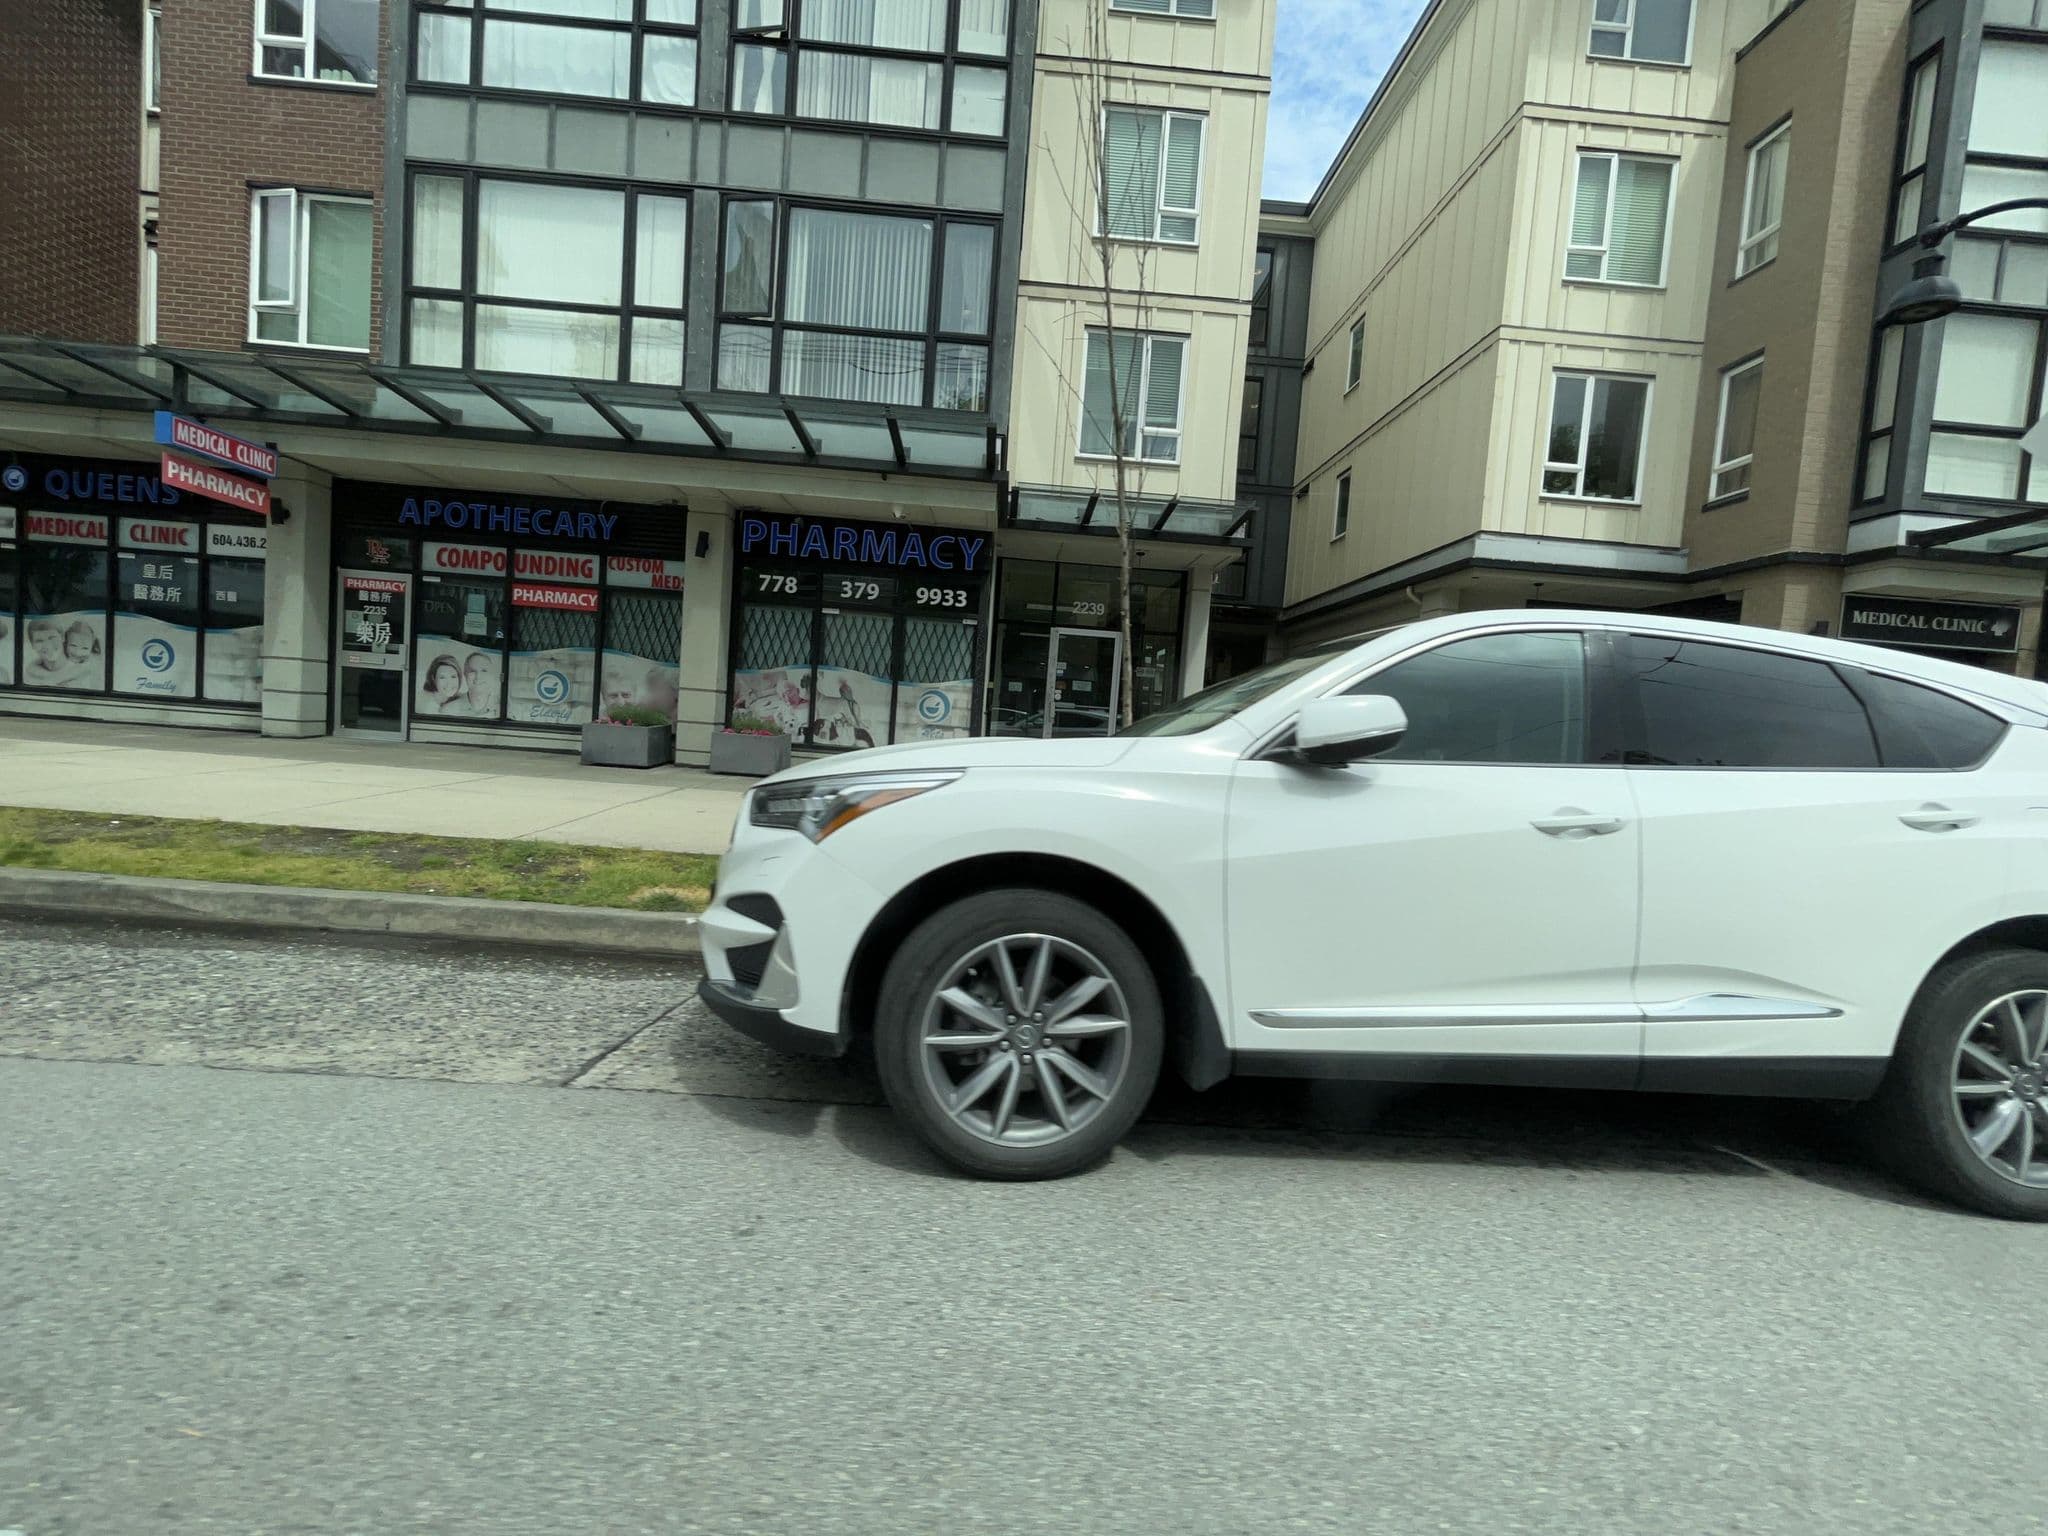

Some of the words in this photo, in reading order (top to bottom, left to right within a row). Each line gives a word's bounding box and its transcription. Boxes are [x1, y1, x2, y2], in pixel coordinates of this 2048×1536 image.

[177, 422, 232, 457] MEDICAL
[236, 443, 273, 472] CLINIC
[45, 468, 181, 505] QUEENS
[167, 460, 266, 506] PHARMACY
[26, 515, 107, 539] MEDICAL
[130, 524, 189, 546] CLINIC
[399, 498, 618, 540] APOTHECARY
[742, 519, 984, 571] PHARMACY
[142, 563, 174, 581] 皇后
[436, 547, 593, 579] COMPOUNDING
[608, 556, 664, 574] CUSTOM
[133, 584, 183, 603] 醫務所
[346, 578, 406, 592] PHARMACY
[513, 587, 599, 608] PHARMACY
[759, 574, 798, 593] 778
[840, 581, 880, 600] 379
[916, 587, 968, 608] 9933
[363, 605, 387, 616] 2235
[1072, 601, 1105, 615] 2239
[1852, 610, 1928, 629] MEDICAL
[1932, 616, 1987, 634] CLINIC
